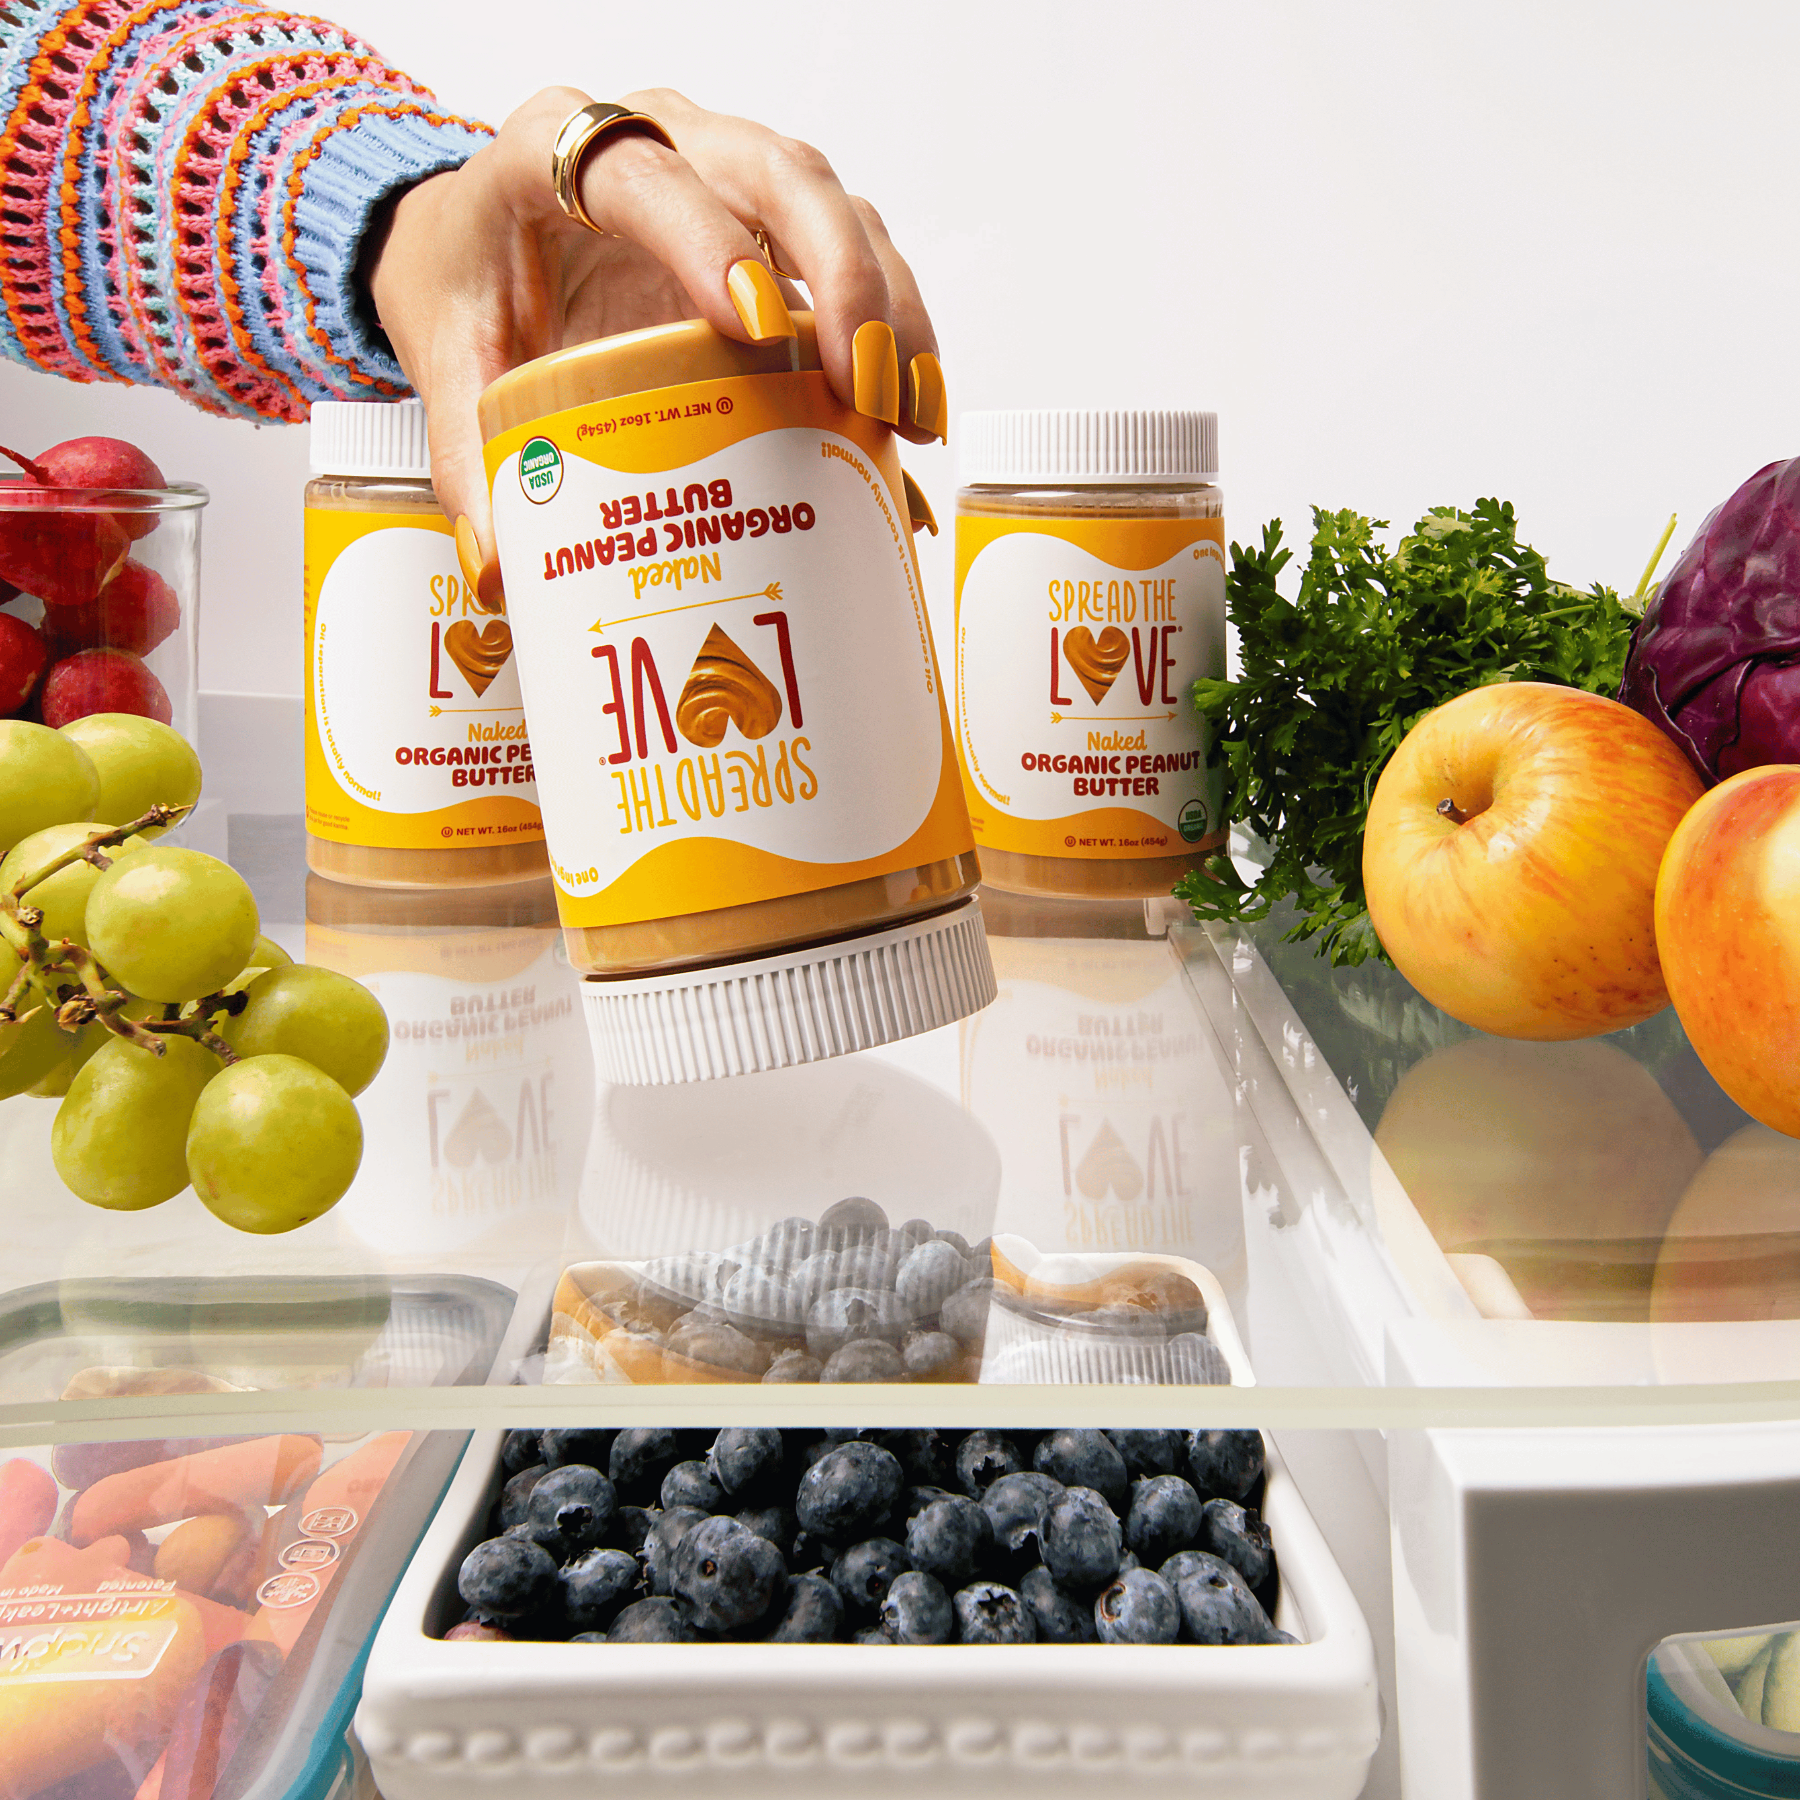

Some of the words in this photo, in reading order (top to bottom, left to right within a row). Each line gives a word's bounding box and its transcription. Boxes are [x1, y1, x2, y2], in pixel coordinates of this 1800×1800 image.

[620, 412, 652, 427] 16oz
[654, 407, 681, 423] WT.
[684, 402, 712, 418] NET
[577, 418, 617, 441] (454g)
[523, 452, 555, 472] ORGANIC
[821, 441, 872, 484] normal!
[528, 470, 554, 490] USDA
[599, 478, 733, 530] BUTTER
[871, 482, 899, 543] totally
[663, 502, 816, 553] ORGANIC
[544, 527, 658, 581] PEANUT
[898, 543, 906, 561] is
[1193, 547, 1209, 560] One
[628, 552, 722, 600] Naked
[903, 561, 929, 663] separation
[1048, 579, 1137, 623] SPREAD
[1139, 578, 1177, 622] THE
[319, 622, 327, 641] Oil
[318, 643, 327, 714] separation
[925, 668, 934, 694] Oil
[468, 720, 529, 743] Naked
[1087, 729, 1148, 751] Naked
[326, 728, 345, 770] totally
[395, 744, 502, 767] ORGANIC
[1021, 752, 1121, 774] ORGANIC
[1126, 750, 1201, 774] PEANUT
[343, 769, 382, 802] normal!
[676, 736, 819, 821] SPREAD
[1073, 777, 1160, 796] BUTTER
[611, 764, 678, 834] THE
[456, 827, 476, 836] NET
[478, 827, 494, 836] WT.
[497, 825, 517, 834] 16oz
[519, 822, 544, 833] (454g
[1119, 839, 1139, 847] 16oz
[1141, 836, 1168, 847] (454g)
[575, 866, 599, 885] One
[18, 1584, 64, 1597] Made
[96, 1579, 177, 1593] Patented
